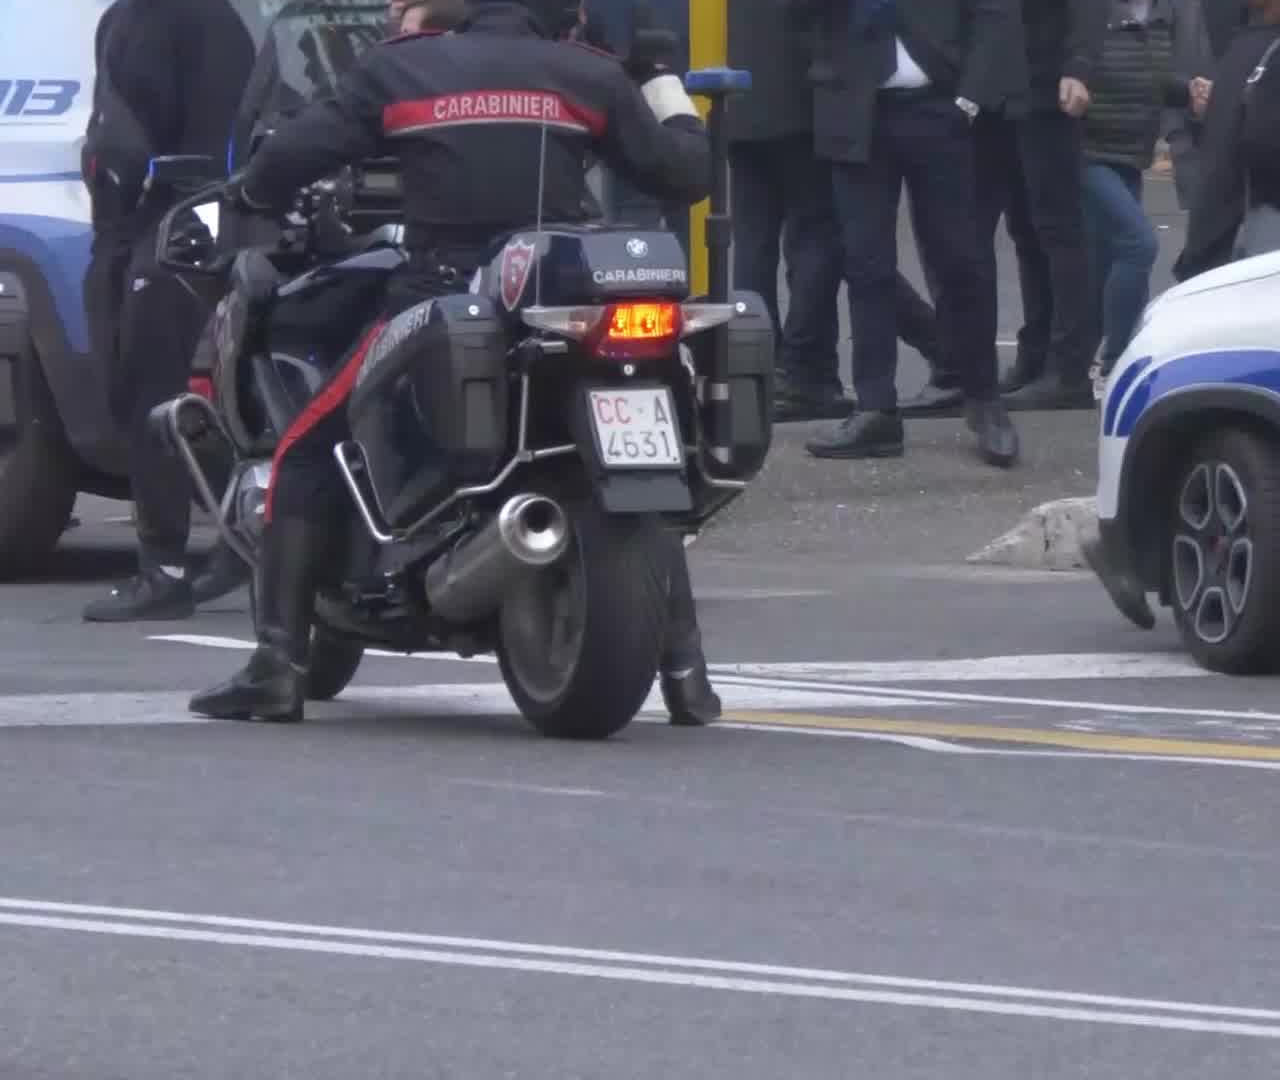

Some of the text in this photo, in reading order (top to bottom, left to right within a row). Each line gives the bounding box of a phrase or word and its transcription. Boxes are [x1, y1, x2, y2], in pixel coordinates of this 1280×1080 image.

[433, 94, 560, 120] CARABINIERI
[593, 268, 688, 284] CARABINIERI
[596, 398, 670, 425] CC A
[606, 432, 671, 460] 4631
